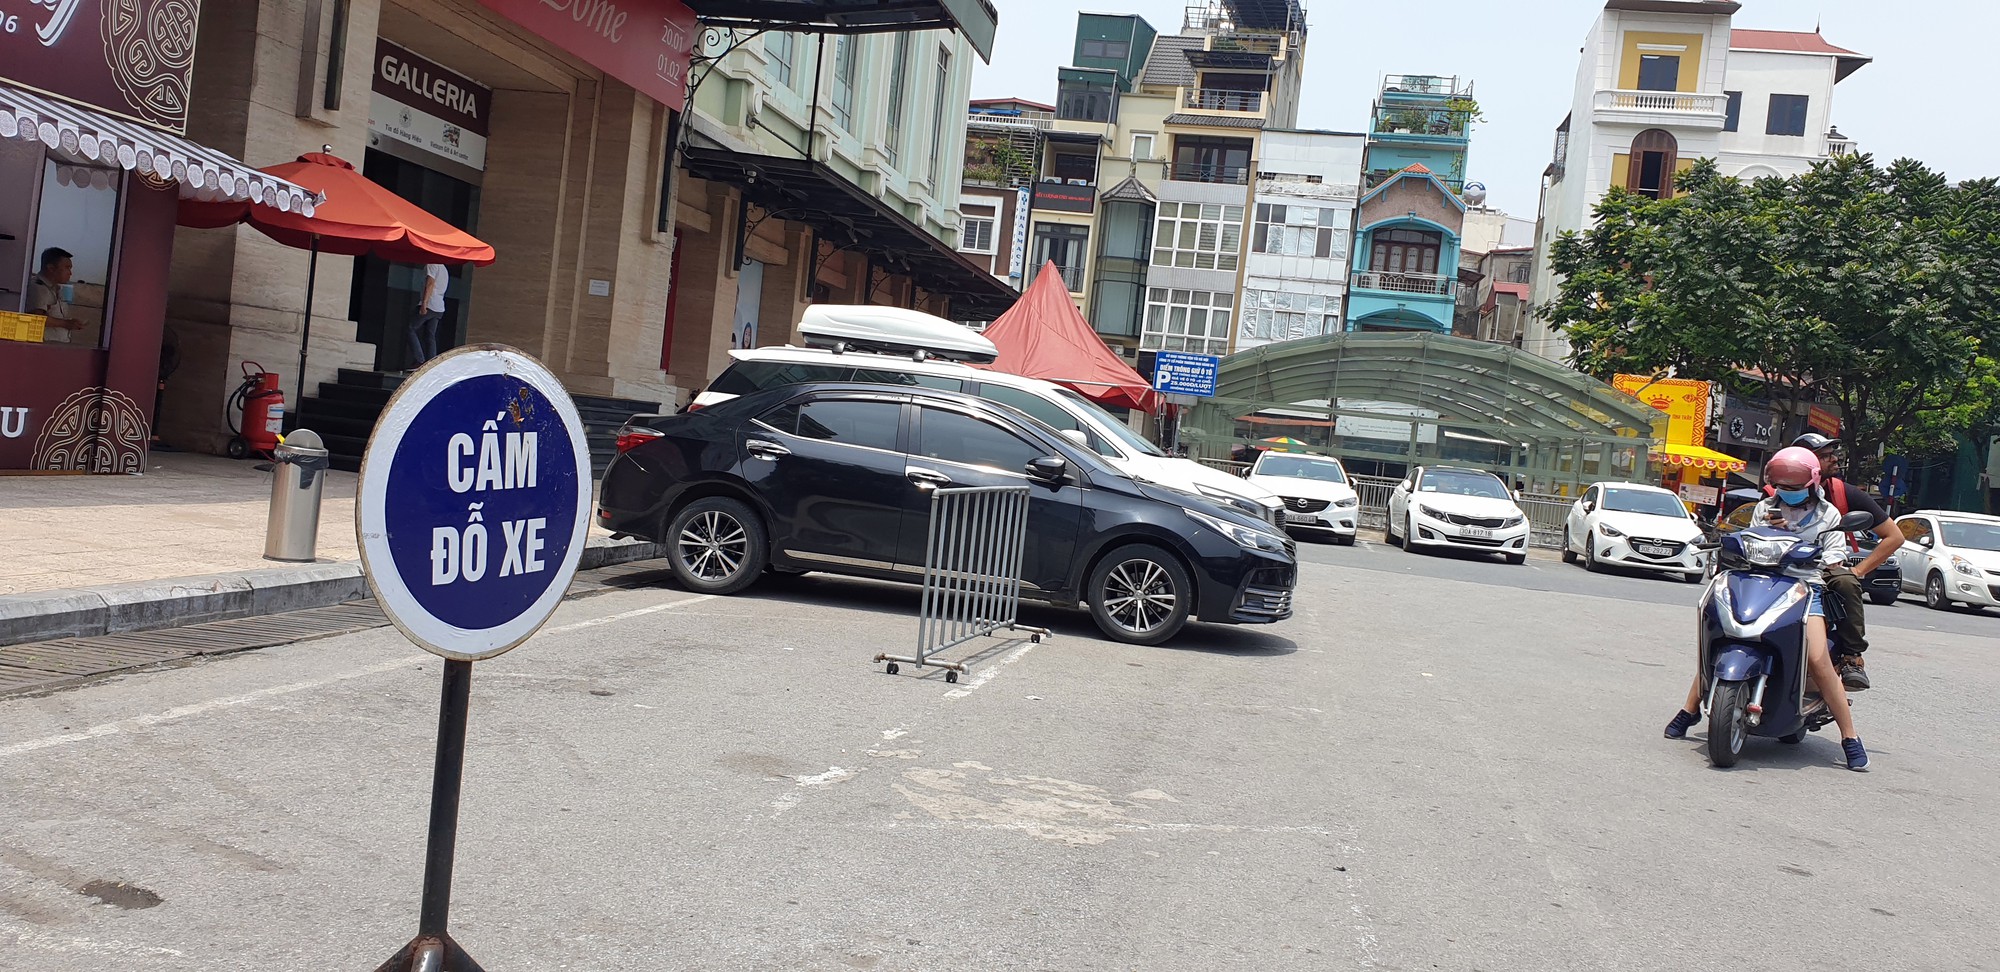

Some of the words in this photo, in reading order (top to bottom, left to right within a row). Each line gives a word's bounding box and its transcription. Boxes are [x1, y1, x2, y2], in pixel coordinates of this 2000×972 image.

[657, 53, 681, 81] 01.02
[662, 25, 683, 53] 20.01
[381, 55, 477, 119] GALLERIA
[1015, 208, 1026, 267] PHARMACY
[1156, 370, 1171, 389] P
[447, 411, 538, 494] CẤM
[430, 501, 488, 586] ĐỖ
[499, 517, 546, 578] XE
